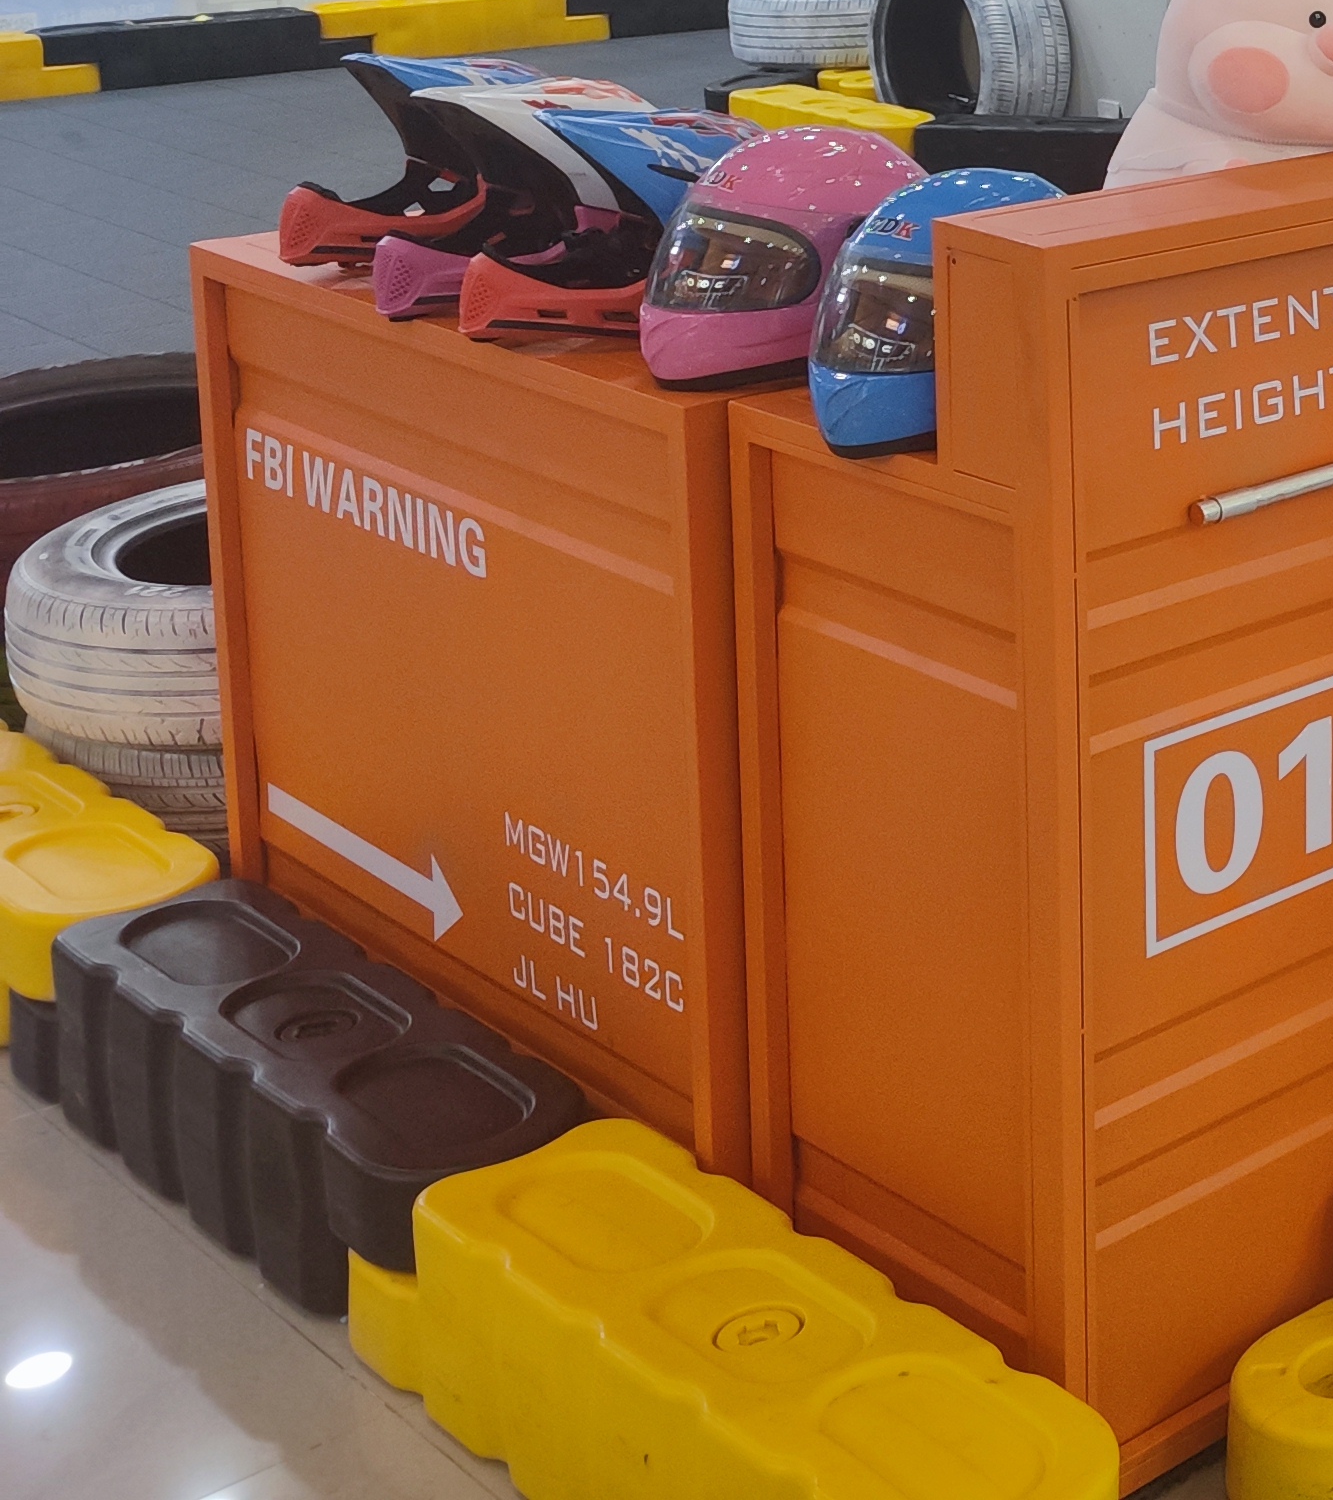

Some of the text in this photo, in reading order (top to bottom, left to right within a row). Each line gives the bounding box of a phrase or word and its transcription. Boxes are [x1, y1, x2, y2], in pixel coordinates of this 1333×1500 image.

[245, 428, 488, 579] FBI WARNING
[1174, 715, 1333, 895] 01
[504, 811, 685, 941] MGW154.9L
[508, 882, 685, 1013] CUBE 182C
[513, 955, 599, 1031] JL HU
